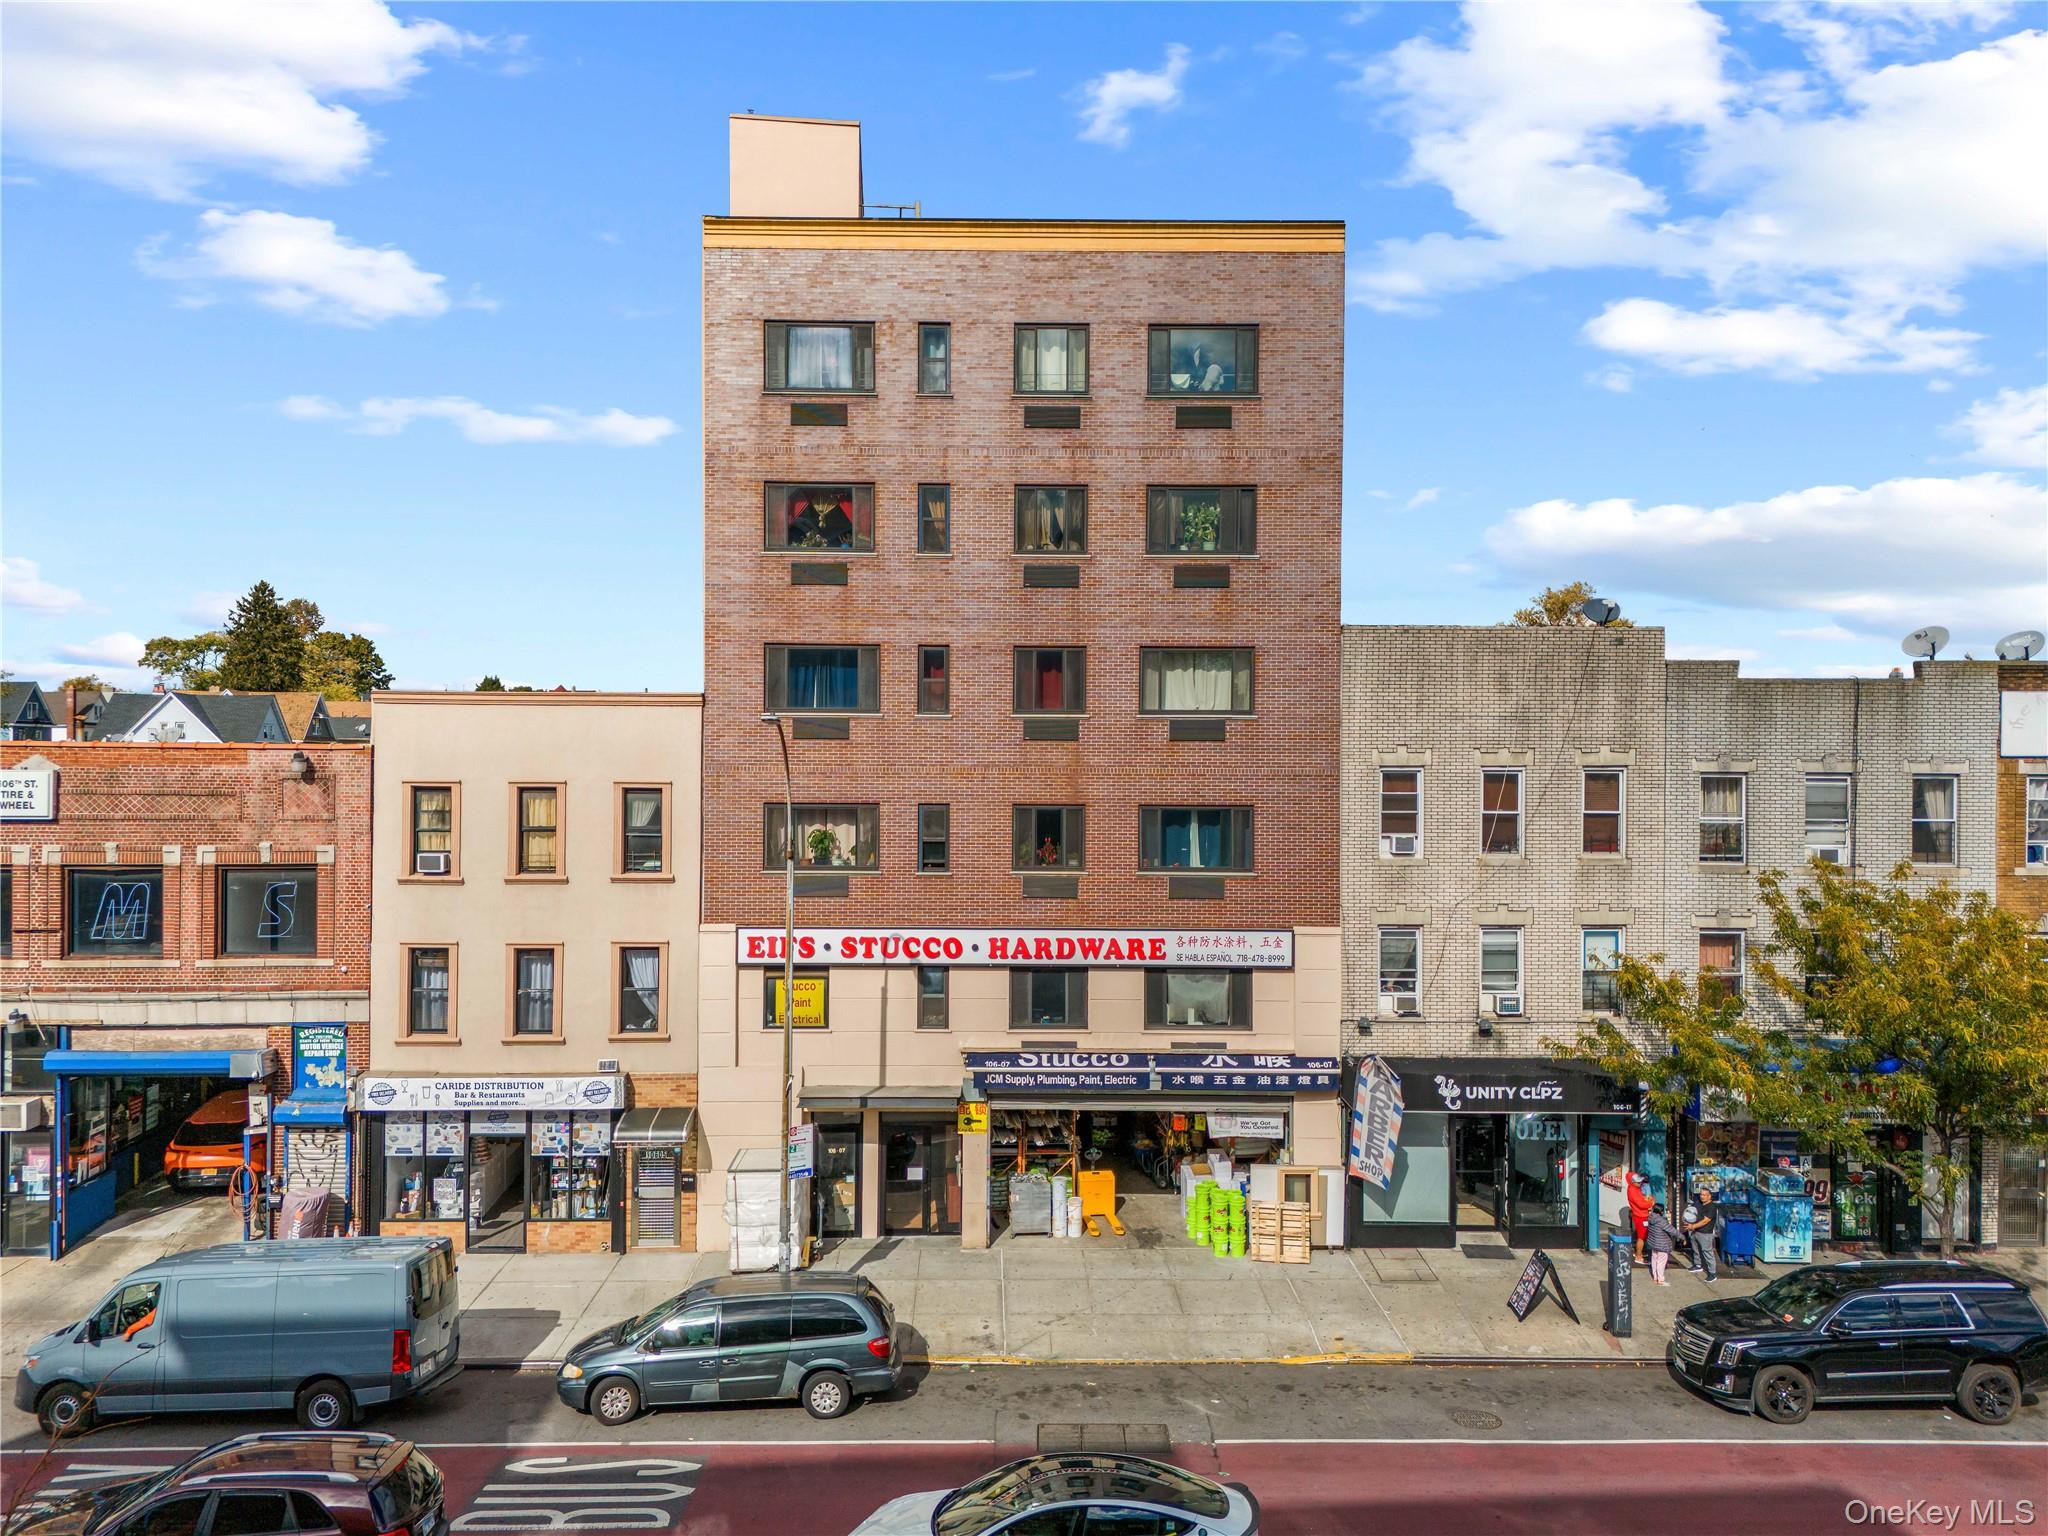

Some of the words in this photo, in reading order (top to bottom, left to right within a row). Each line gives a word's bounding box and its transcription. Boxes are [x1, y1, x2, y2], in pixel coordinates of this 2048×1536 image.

[24, 780, 38, 788] ST.
[1, 791, 24, 799] TIRE
[27, 791, 34, 799] &
[0, 802, 36, 810] WHEEL
[91, 883, 150, 939] M
[258, 881, 297, 938] S
[840, 936, 964, 960] STUCCO
[988, 937, 1167, 961] HARDWARE
[1176, 953, 1184, 962] SE
[1185, 953, 1204, 962] HABLA
[1206, 951, 1233, 963] ESPAÑOL
[1237, 954, 1286, 963] 718-478-8999
[782, 981, 817, 991] ucco
[779, 1013, 821, 1024] Ectrical
[299, 1027, 344, 1038] REGISTERED
[435, 1082, 471, 1090] CARIDE
[474, 1082, 544, 1090] DISTRIBUTION
[984, 1075, 1003, 1084] JCM
[1005, 1075, 1035, 1086] Supply,
[1037, 1075, 1077, 1086] Plumbing,
[1079, 1075, 1103, 1086] Paint,
[1104, 1075, 1137, 1085] Electric
[1465, 1087, 1517, 1100] UNITY
[1364, 1064, 1394, 1168] BARBER
[1516, 1120, 1572, 1140] OPEN
[1358, 1160, 1383, 1178] SHOP
[450, 1456, 703, 1531] BUS
